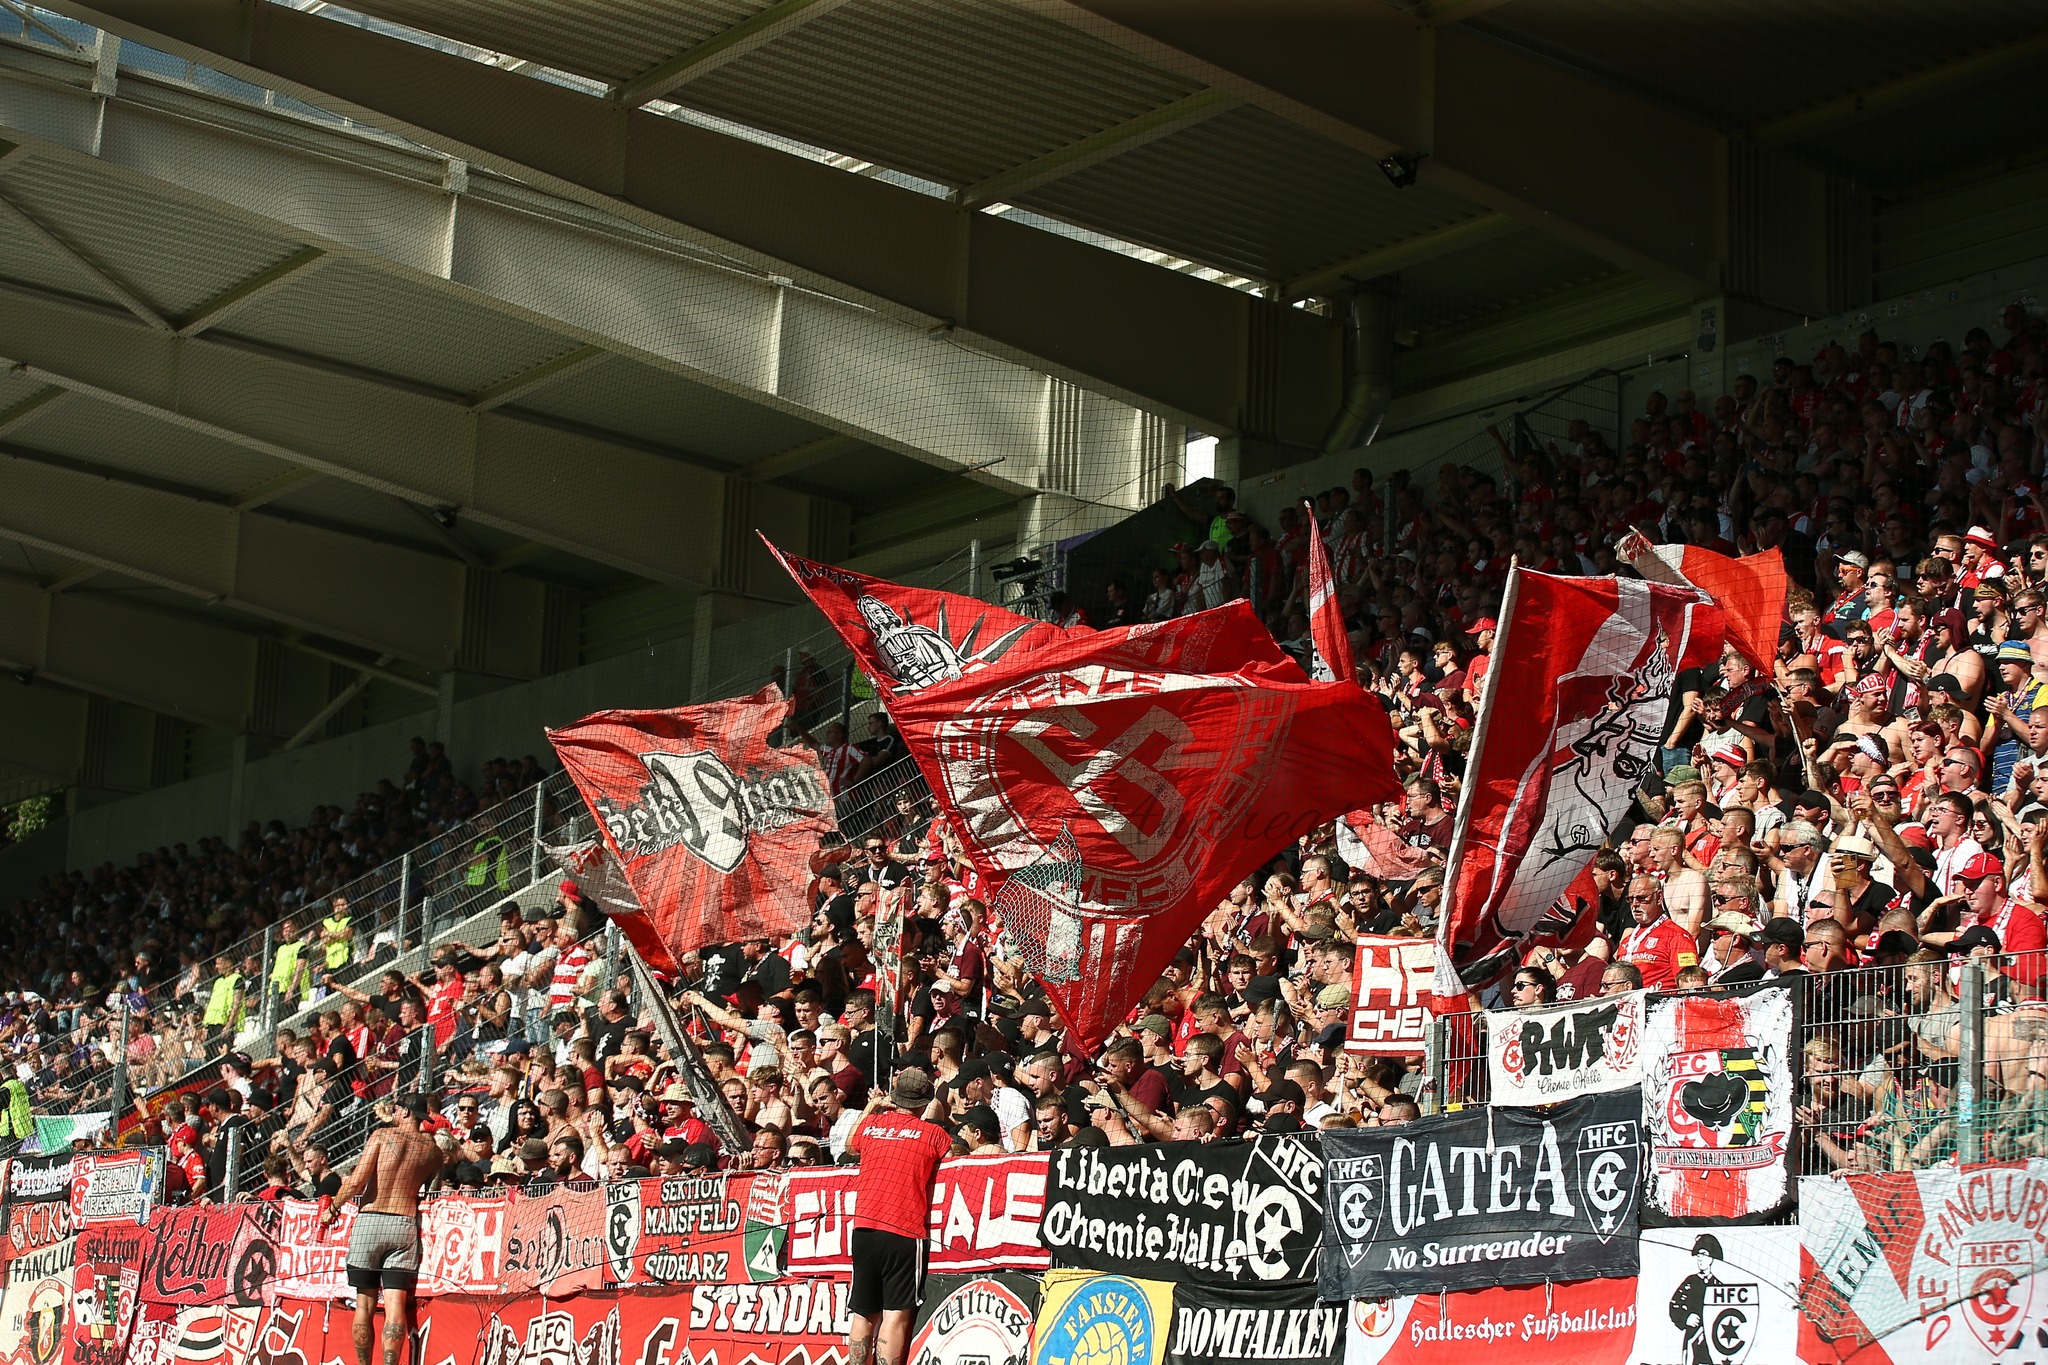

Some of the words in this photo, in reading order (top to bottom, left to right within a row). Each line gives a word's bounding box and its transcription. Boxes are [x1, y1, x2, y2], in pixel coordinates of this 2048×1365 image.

[1357, 944, 1434, 1008] HF
[1499, 1024, 1519, 1045] HFC
[1588, 1125, 1628, 1149] HFC
[1056, 1148, 1170, 1205] Libertà
[1271, 1137, 1321, 1195] HFC
[1338, 1157, 1373, 1180] HFC
[607, 1185, 632, 1203] HFC
[660, 1179, 725, 1203] SEKTION
[446, 1210, 468, 1224] HFC
[645, 1201, 741, 1236] MANSFELD
[1043, 1201, 1164, 1262] Chemie
[1166, 1213, 1247, 1276] Halle
[1384, 1243, 1418, 1271] No
[1422, 1232, 1572, 1268] Surrender
[1970, 1244, 2021, 1264] HFC
[121, 1271, 136, 1288] HFC
[644, 1244, 729, 1282] SÜDHARZ
[690, 1281, 851, 1336] STENDAL
[1713, 1287, 1749, 1304] HFC
[13, 1313, 23, 1332] 19
[933, 1288, 1029, 1338] Ultras
[1064, 1291, 1146, 1362] FANSZENE
[1170, 1307, 1343, 1359] DOMFALKEN
[1411, 1316, 1515, 1348] Hallescher
